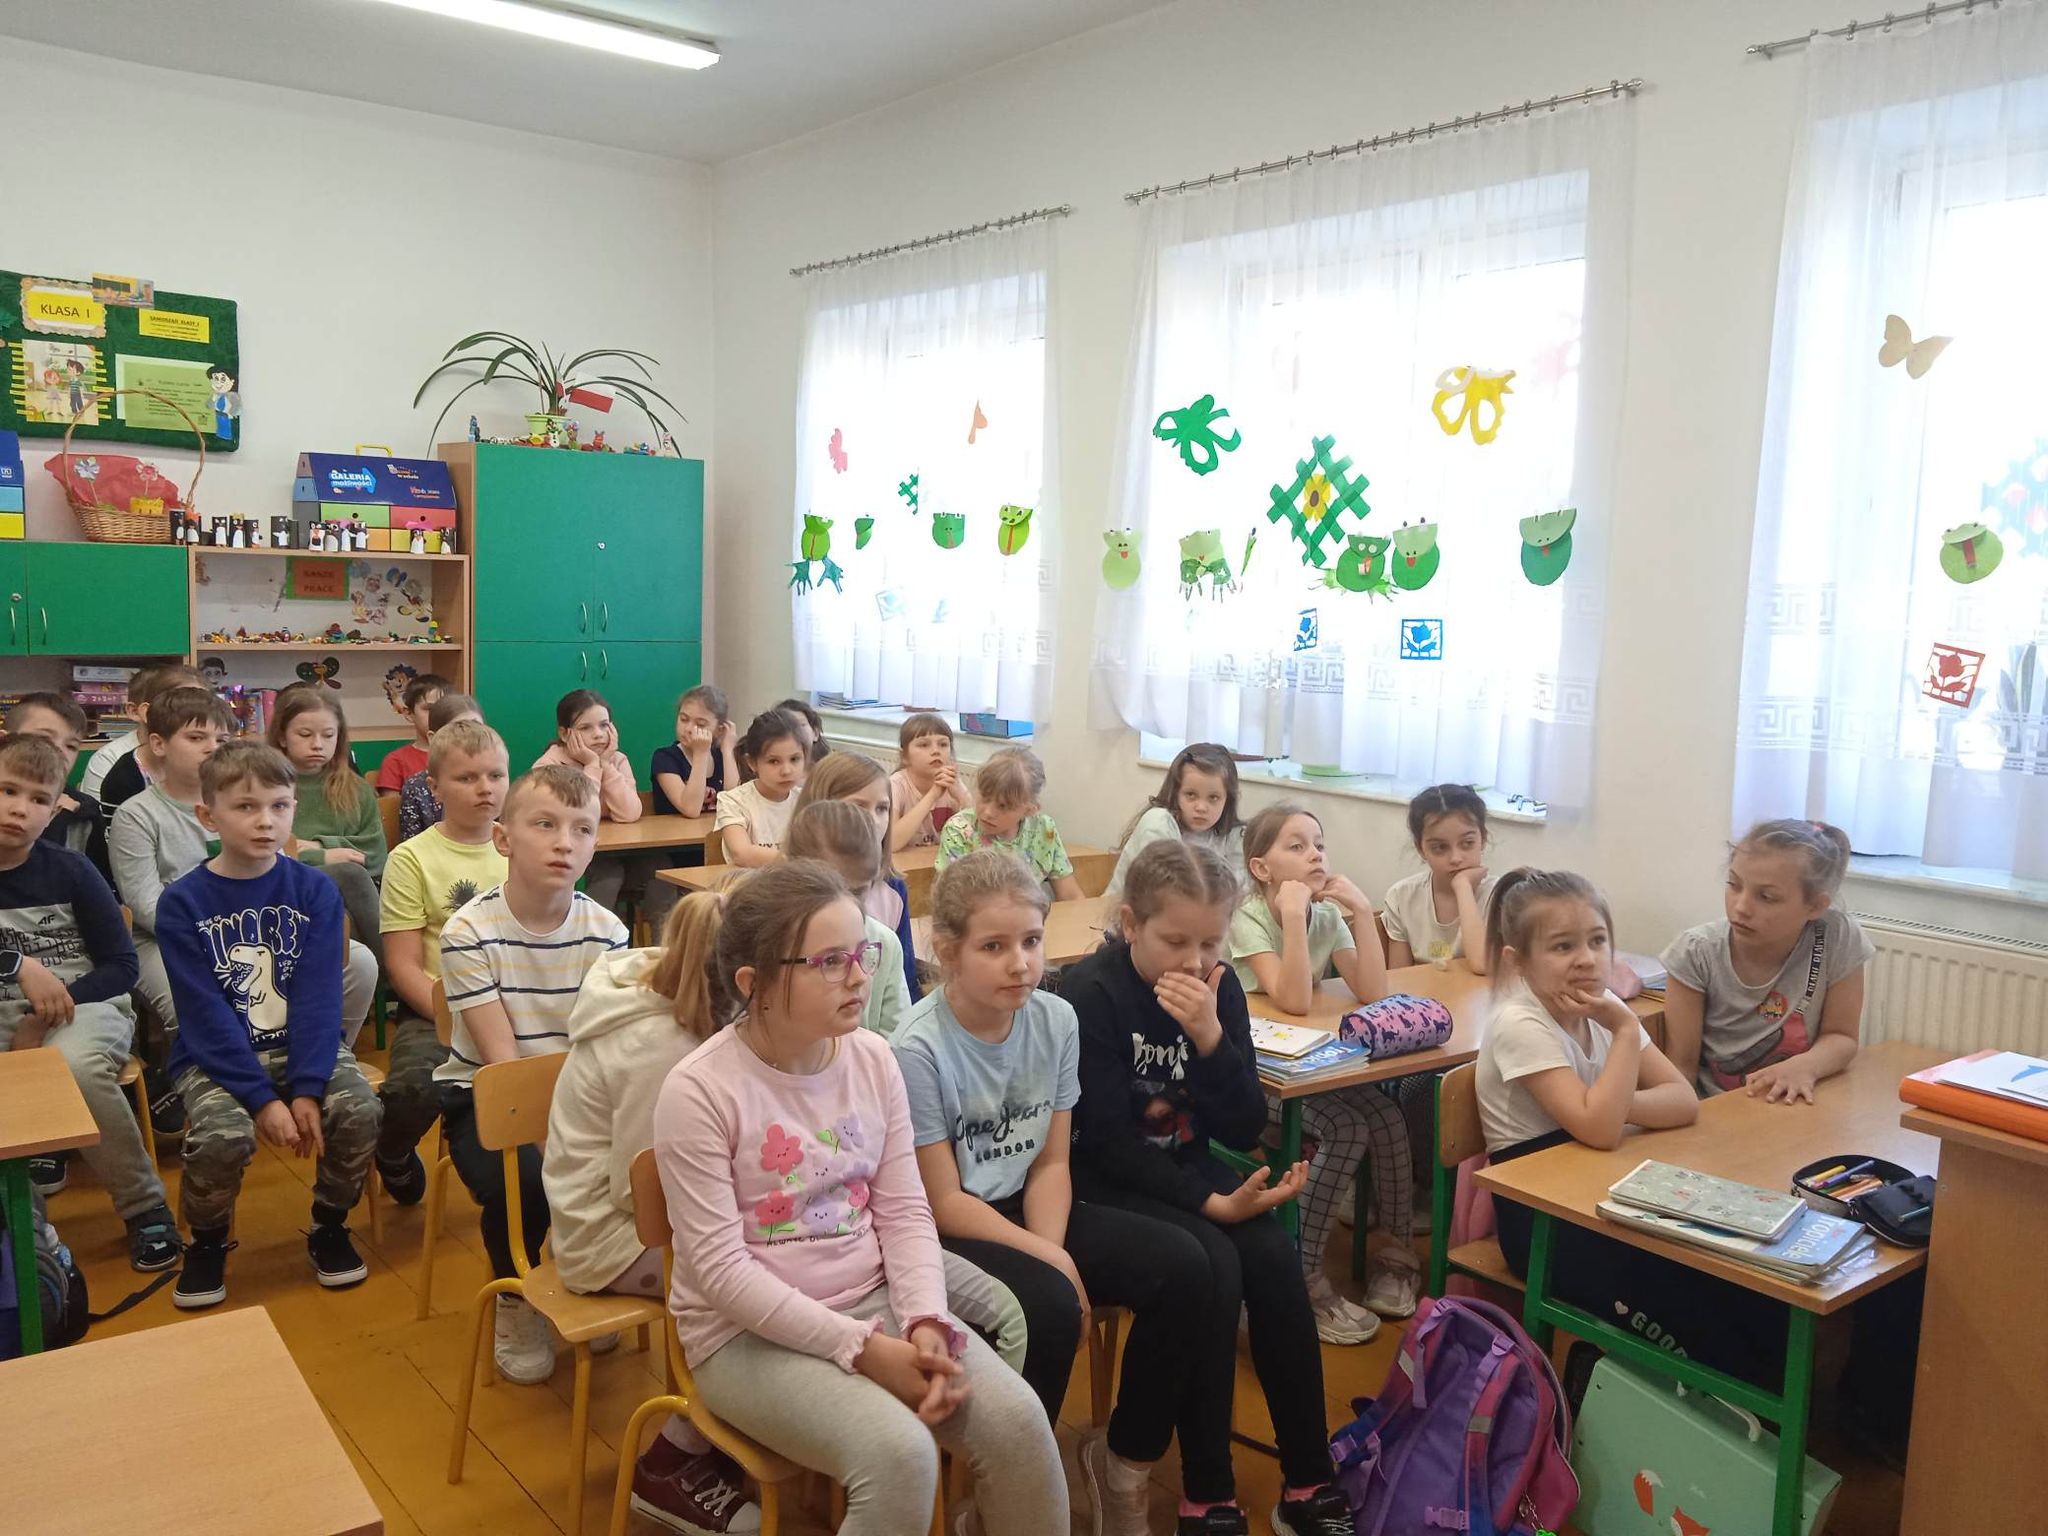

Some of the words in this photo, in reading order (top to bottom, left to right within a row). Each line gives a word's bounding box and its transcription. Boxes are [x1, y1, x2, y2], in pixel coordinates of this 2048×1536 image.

[40, 304, 80, 318] KLASA
[331, 472, 371, 482] GALERIA
[975, 1138, 1035, 1164] LONDON
[1782, 1214, 1846, 1259] Tropiciele
